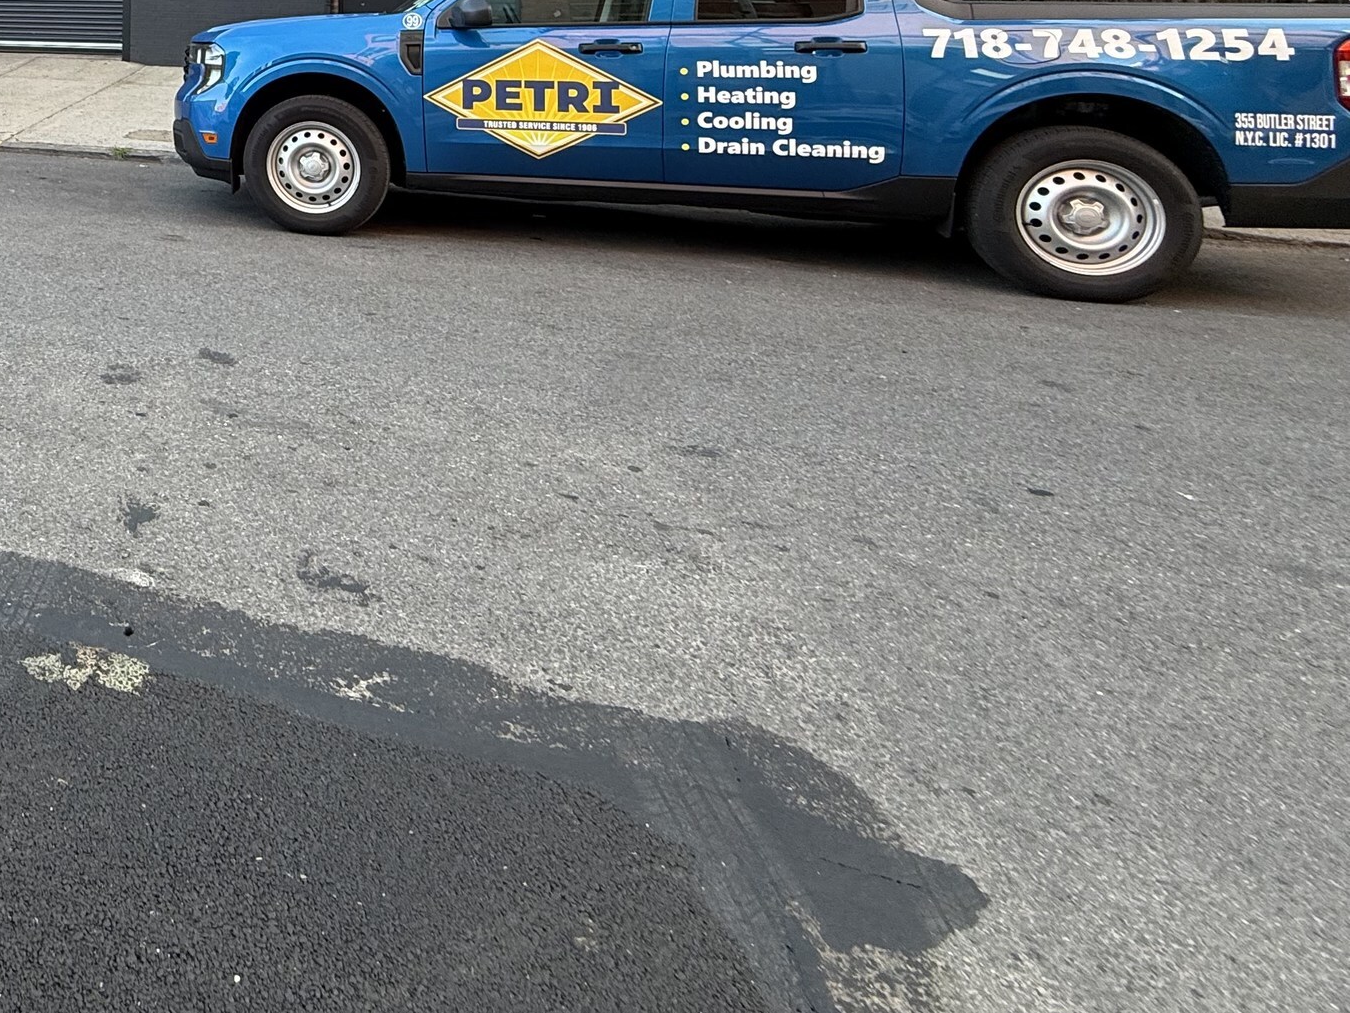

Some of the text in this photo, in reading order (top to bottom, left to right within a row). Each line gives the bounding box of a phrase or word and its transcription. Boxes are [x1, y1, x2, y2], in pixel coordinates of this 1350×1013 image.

[406, 15, 420, 27] 99
[922, 28, 1295, 61] 718-748-1254
[696, 60, 817, 83] Plumbing
[461, 79, 621, 114] PETRI
[697, 87, 796, 109] Heating
[483, 120, 517, 129] TRUSTED
[518, 121, 551, 130] SERVICE
[552, 122, 576, 131] SINCE
[697, 111, 793, 135] Cooling
[1235, 112, 1336, 131] 355 BUTLER STREET
[698, 137, 885, 164] Drain Cleaning
[1235, 130, 1336, 149] N.Y.C. LIC. #1301
